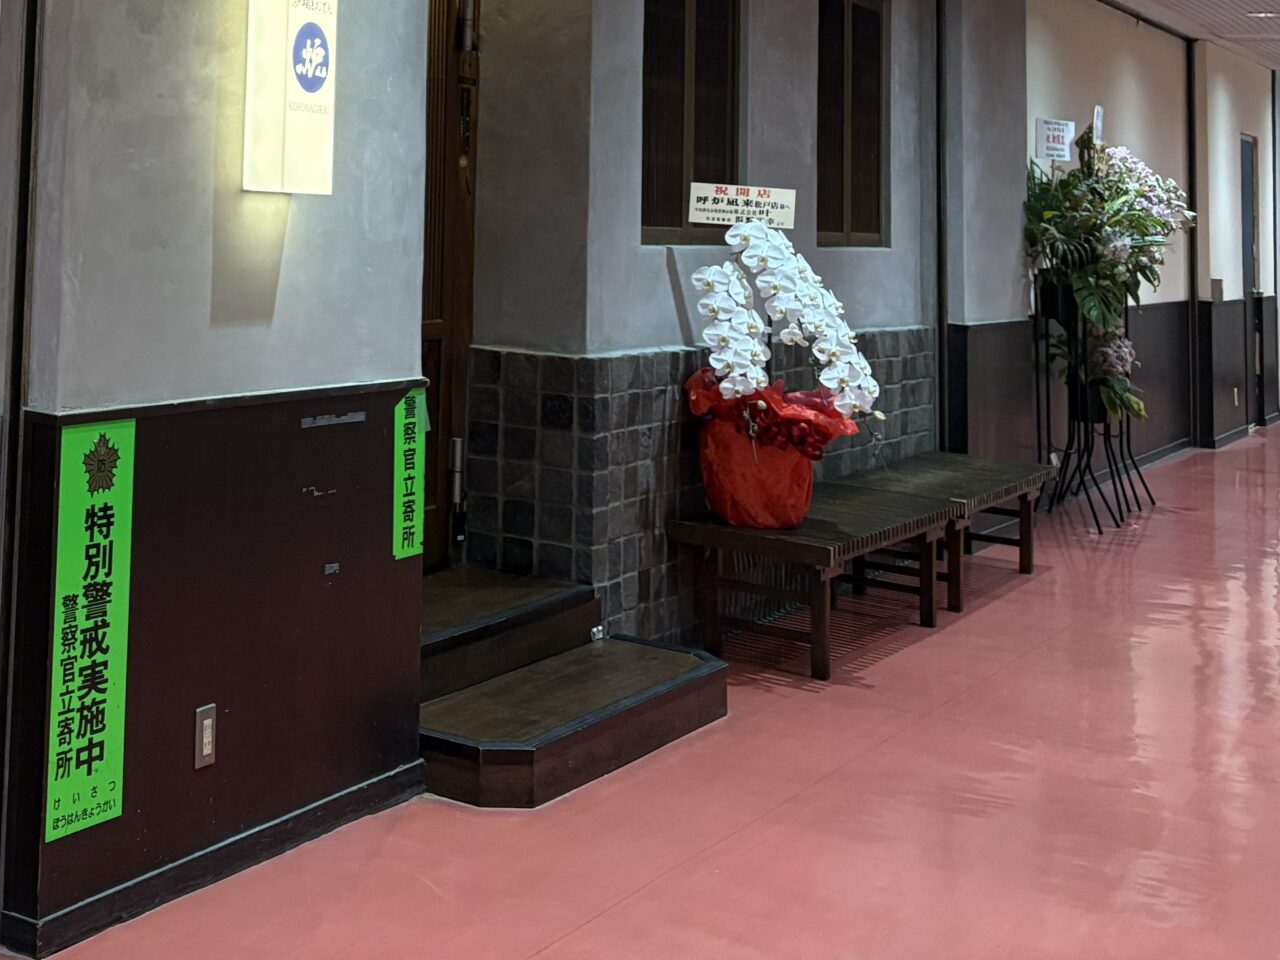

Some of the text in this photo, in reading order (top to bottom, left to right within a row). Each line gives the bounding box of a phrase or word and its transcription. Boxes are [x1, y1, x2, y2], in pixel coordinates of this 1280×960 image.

[401, 394, 417, 550] 警察官立寄所
[54, 593, 80, 782] 警察官立寄所
[74, 501, 115, 777] 特別警戒実施中
[53, 780, 117, 811] けいさつ
